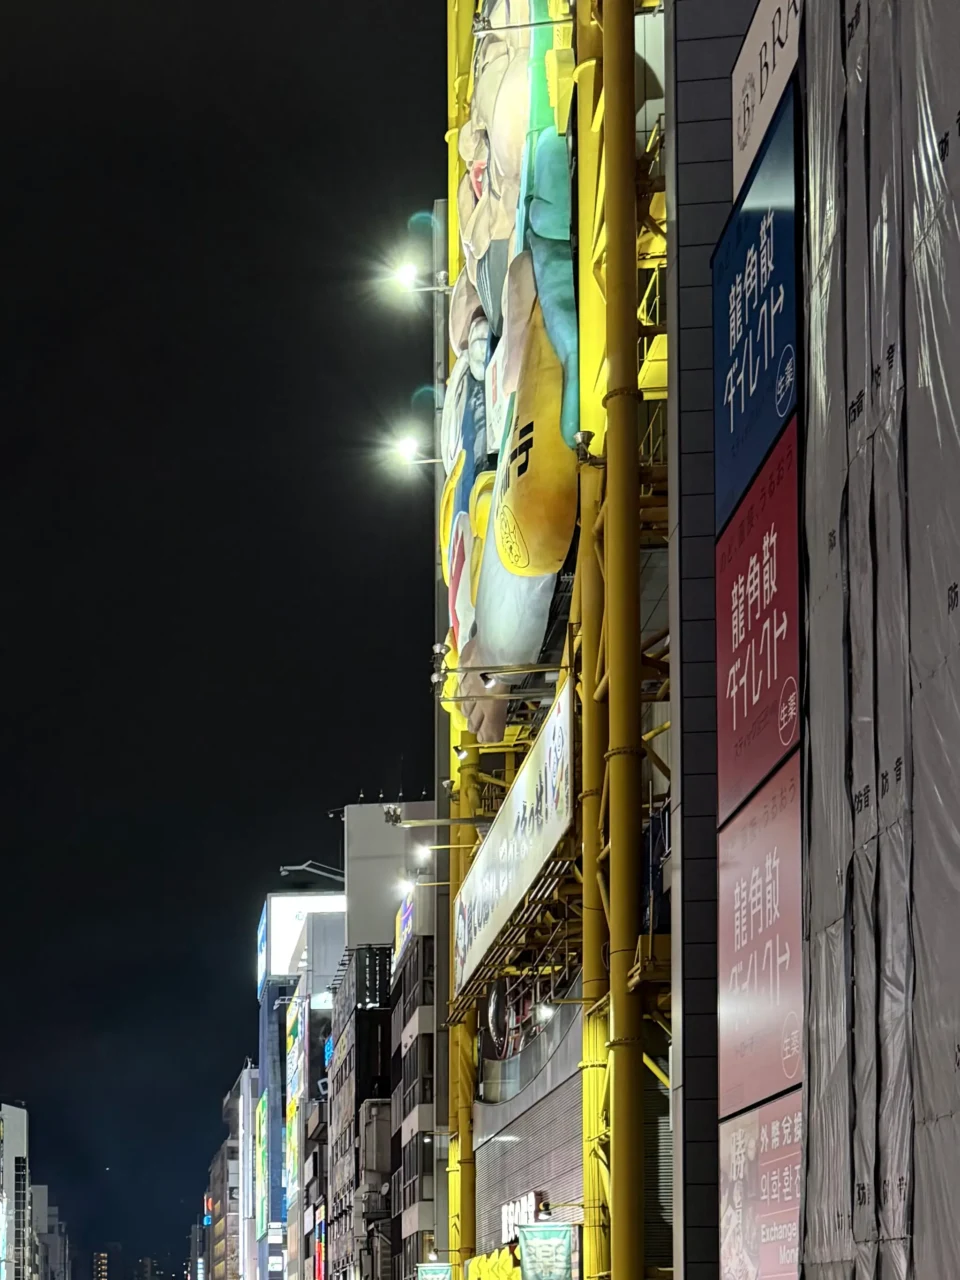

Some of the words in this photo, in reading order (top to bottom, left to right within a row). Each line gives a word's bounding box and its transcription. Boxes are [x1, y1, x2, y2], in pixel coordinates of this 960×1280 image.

[728, 207, 776, 356] 龍角散
[723, 282, 786, 433] ダイレクト
[777, 356, 795, 408] 生薬
[731, 522, 778, 654] 龍角散
[726, 607, 788, 731] ダイレクト
[780, 691, 797, 728] 生薬
[734, 845, 781, 954] 龍角散
[760, 1220, 797, 1244] Exchange
